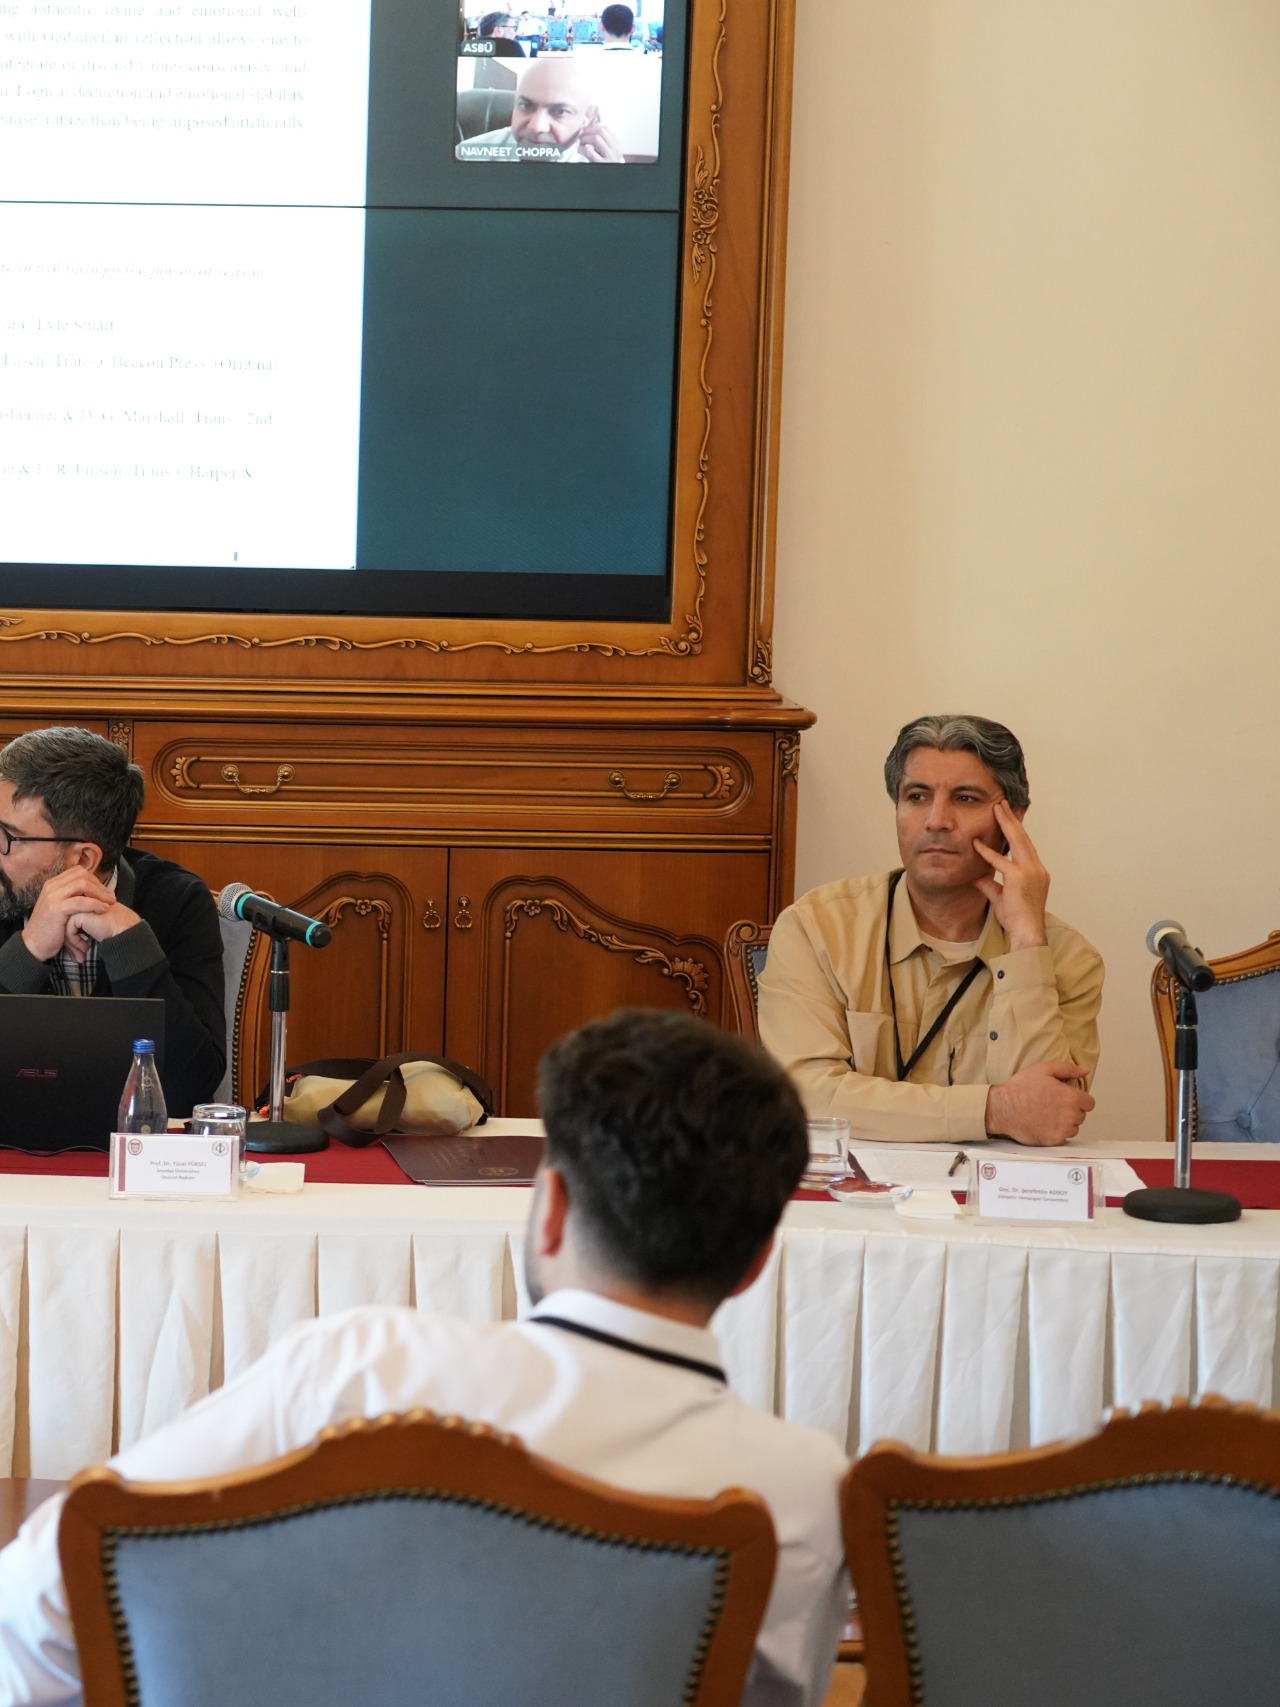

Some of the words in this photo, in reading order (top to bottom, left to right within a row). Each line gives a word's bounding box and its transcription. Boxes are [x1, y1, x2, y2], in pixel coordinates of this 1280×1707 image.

[156, 4, 182, 16] and
[192, 4, 261, 17] emotional
[460, 146, 513, 157] NAVNEET
[515, 147, 561, 157] CHOPRA
[15, 1068, 58, 1078] ASUS
